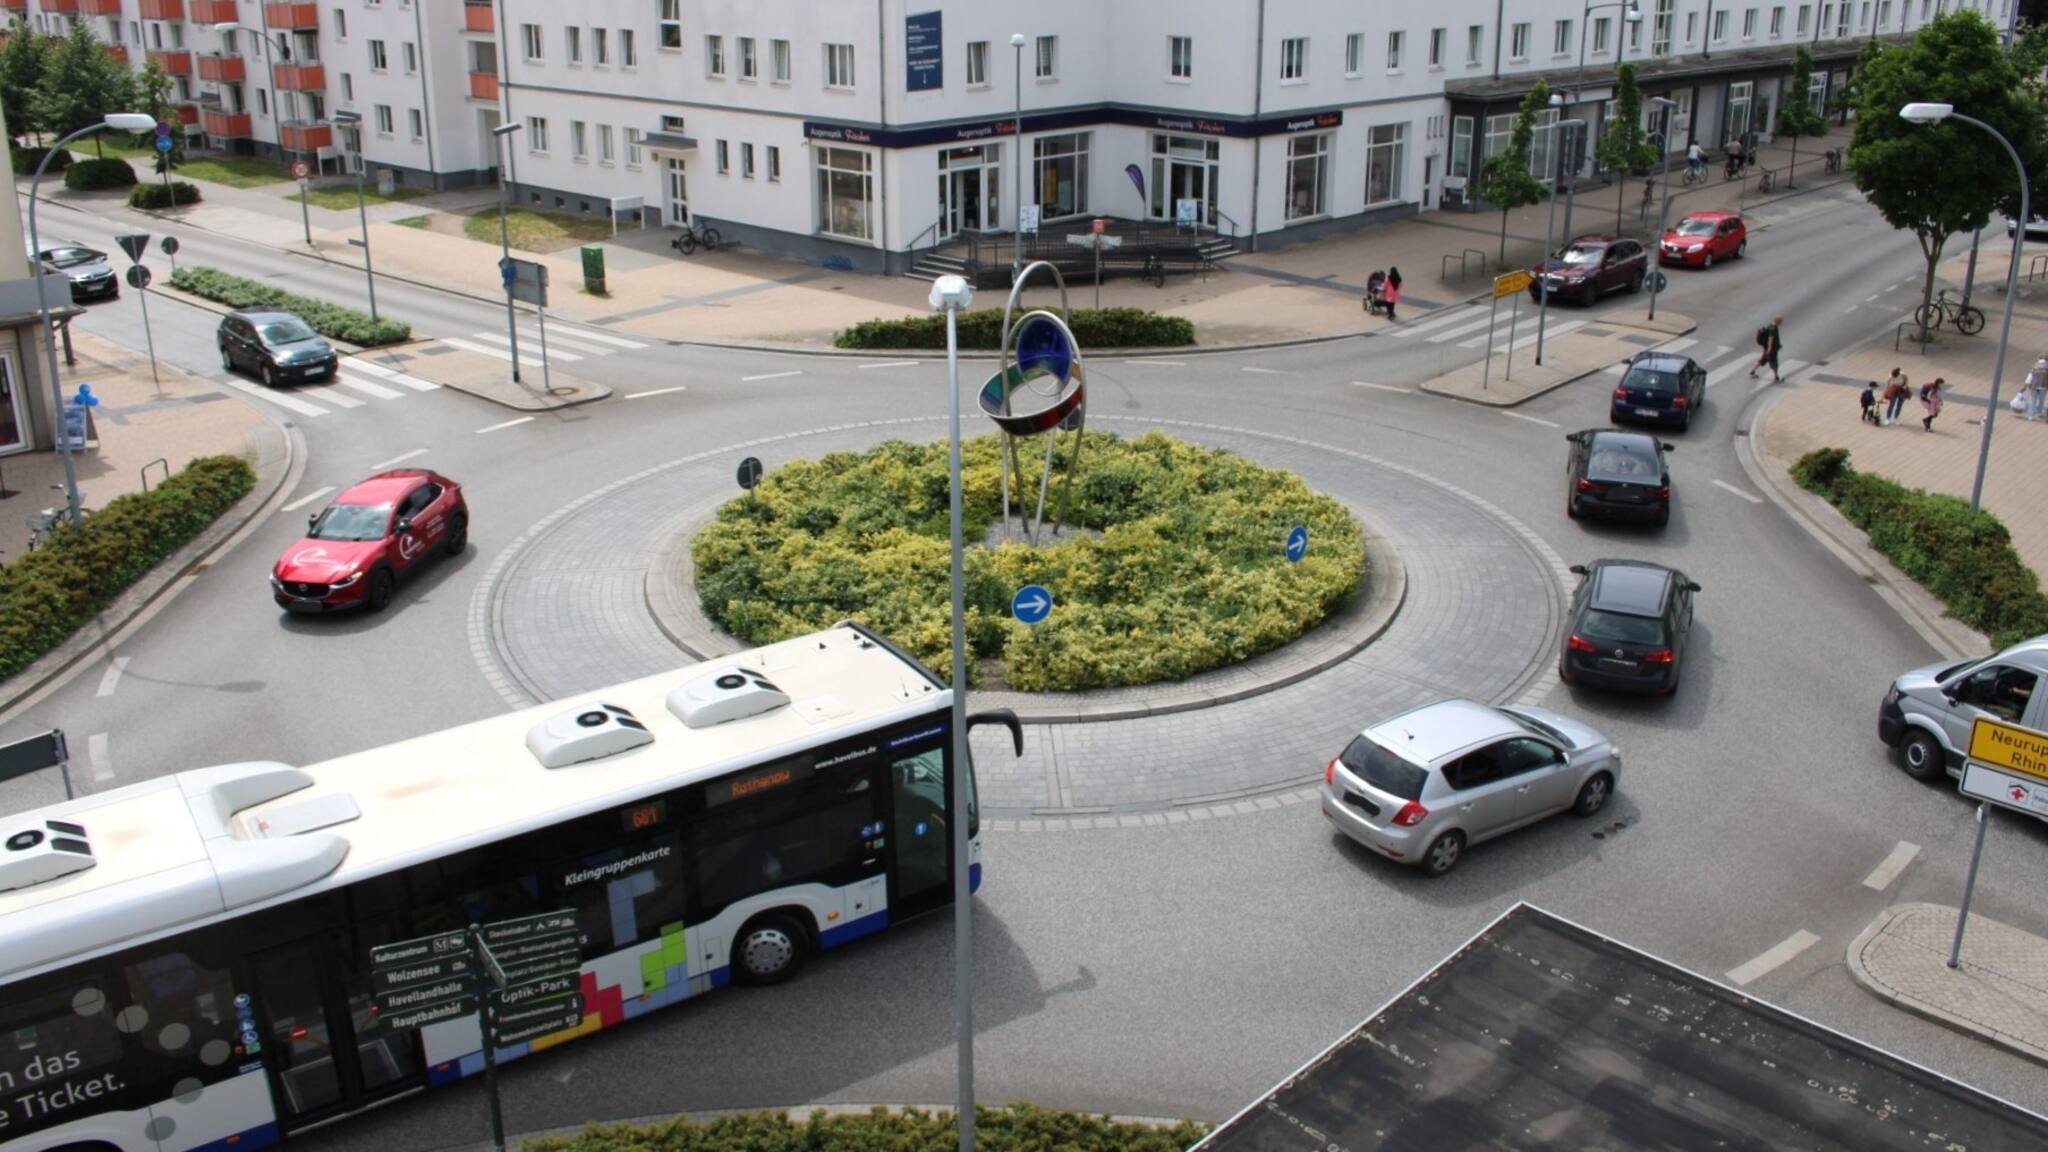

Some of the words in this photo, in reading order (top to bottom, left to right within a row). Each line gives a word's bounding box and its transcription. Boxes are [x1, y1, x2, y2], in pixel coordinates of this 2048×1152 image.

[810, 127, 842, 140] Augenoptik
[957, 125, 992, 139] Augenoptik
[1157, 117, 1193, 130] Augenoptik
[564, 846, 671, 887] Kleingruppenkarte
[387, 965, 440, 983] Wolzensee
[388, 982, 463, 1007] Havellandhalle
[501, 978, 571, 1003] Optik-Park
[392, 1002, 462, 1029] Hauptbahnhof
[24, 1050, 80, 1080] das
[16, 1072, 125, 1118] Ticket.
